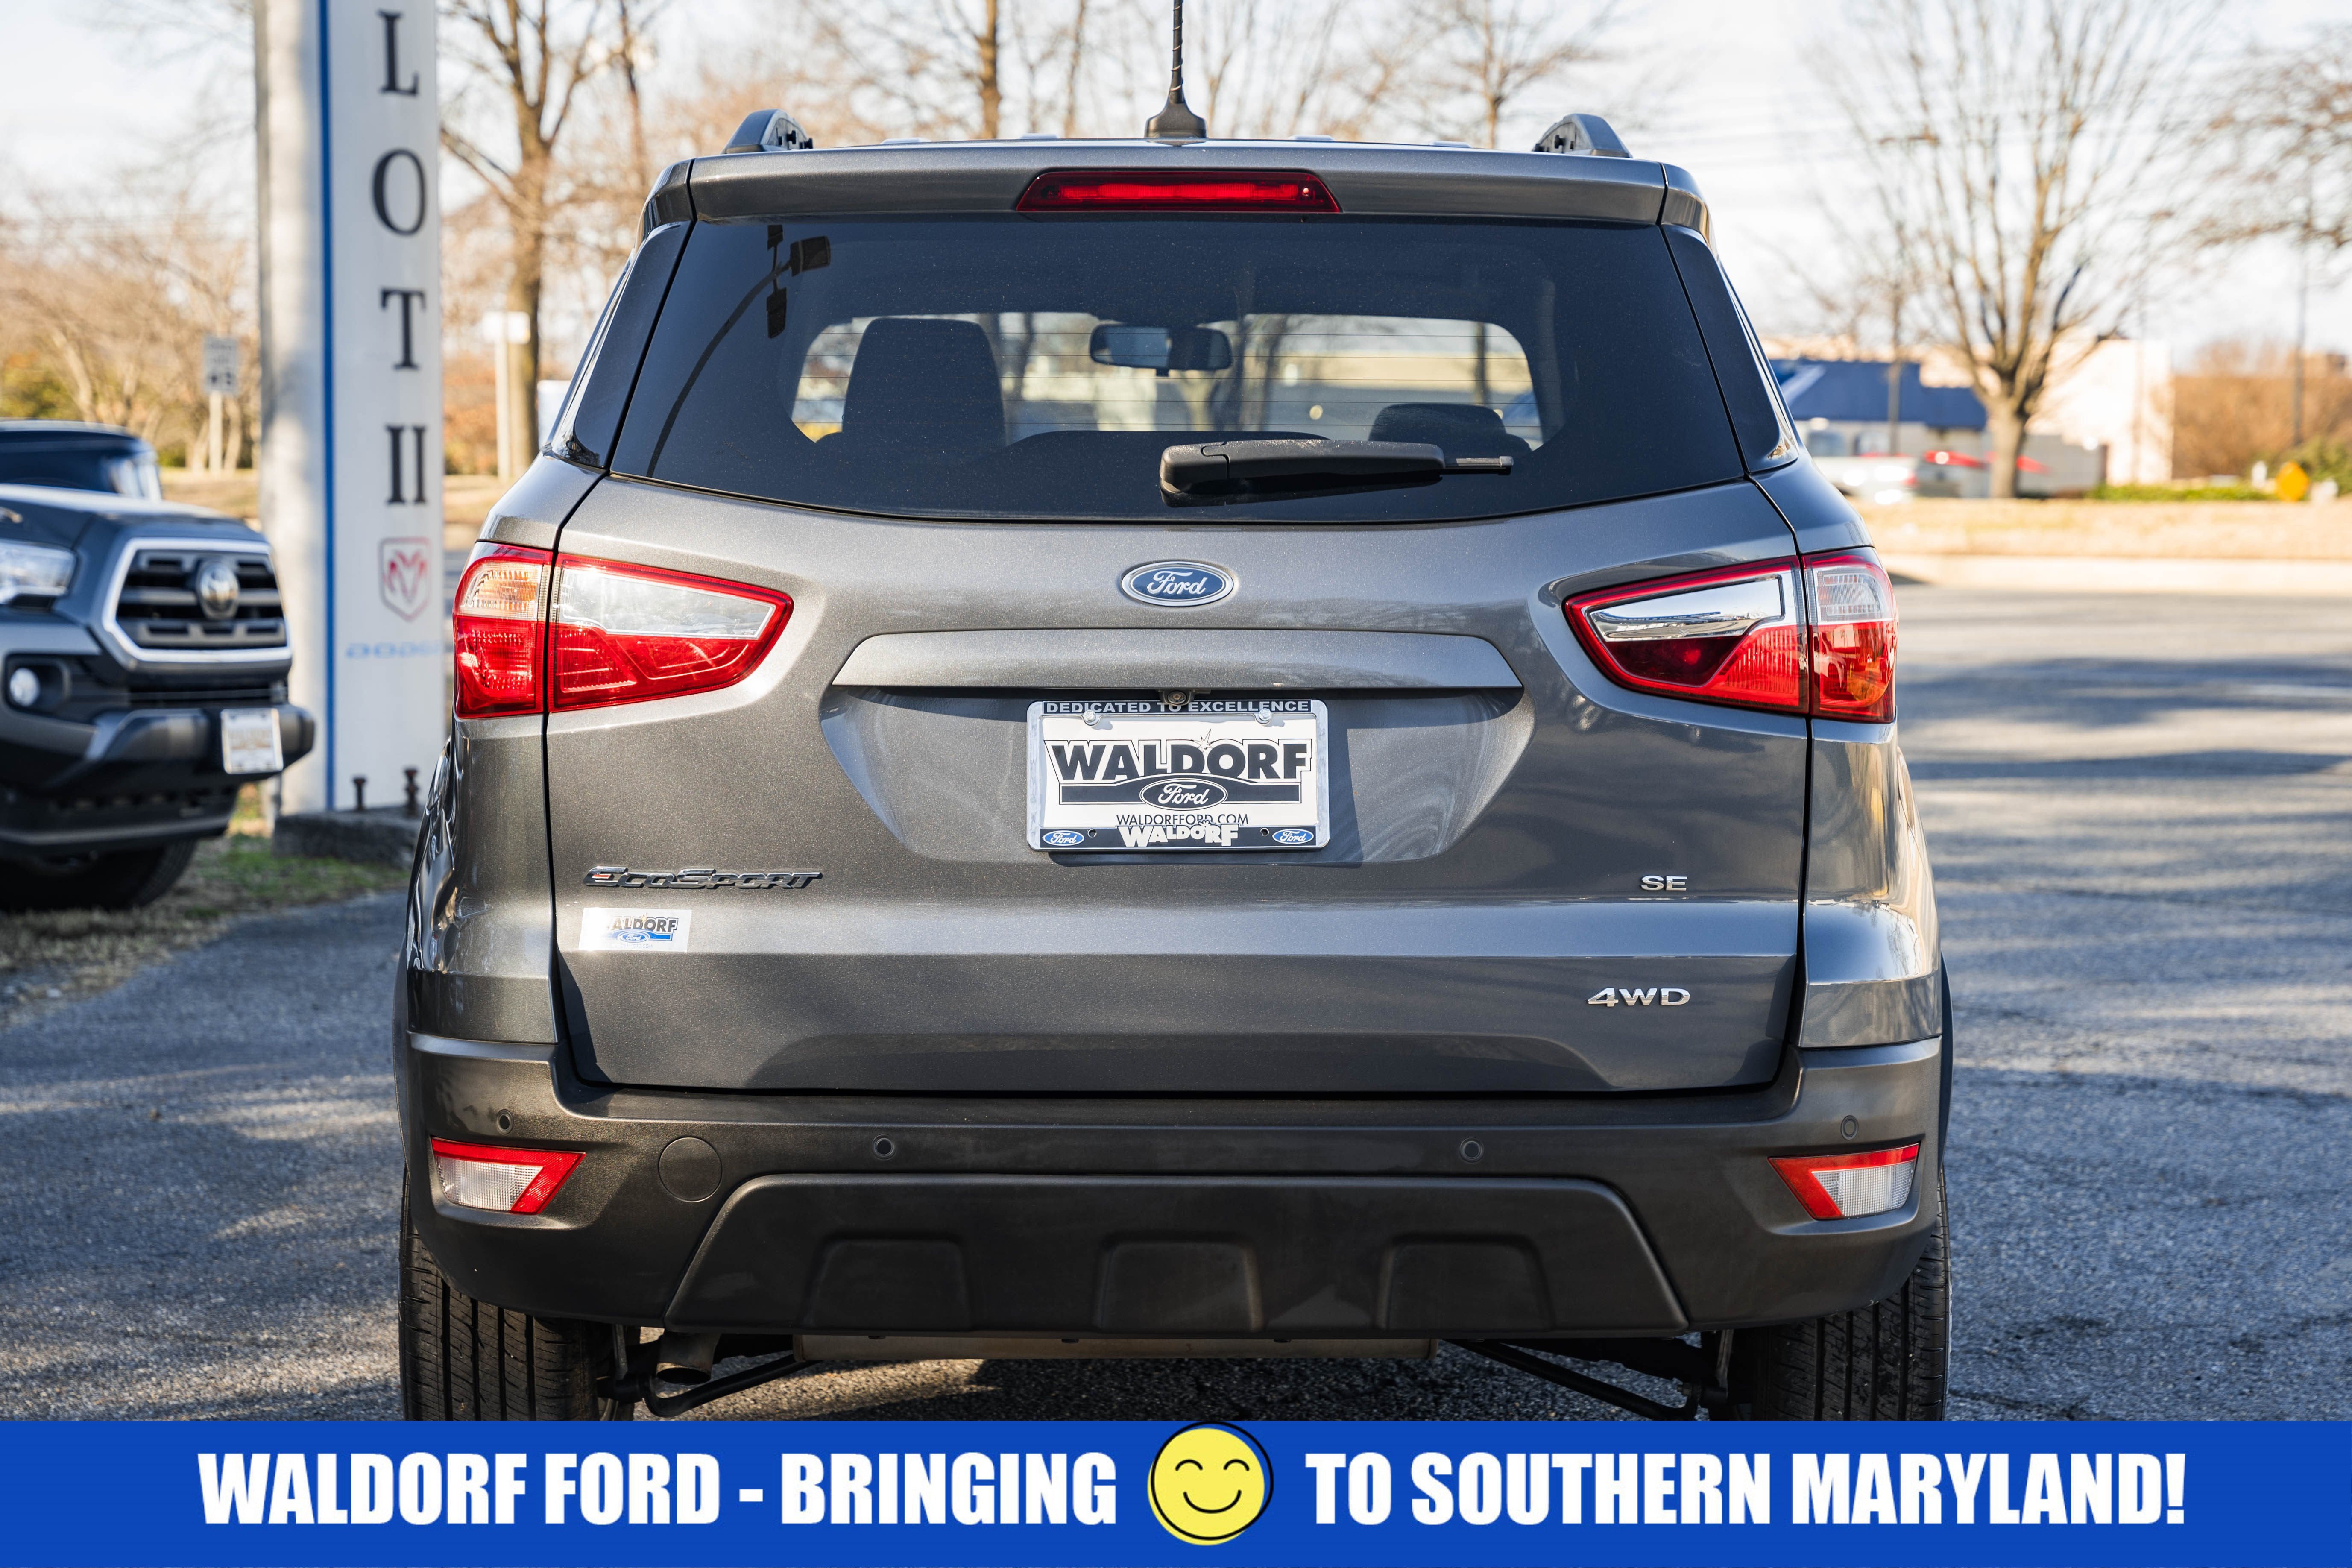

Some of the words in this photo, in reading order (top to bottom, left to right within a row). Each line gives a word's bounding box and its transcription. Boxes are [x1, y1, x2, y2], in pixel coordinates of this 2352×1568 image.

[371, 9, 427, 371] LOT
[1147, 570, 1208, 595] Ford
[1046, 702, 1151, 713] DEDICATED
[1157, 702, 1182, 712] TO
[1188, 701, 1309, 712] EXCELLENCE
[1051, 743, 1308, 780] WALDORF
[1158, 781, 1209, 806] Ford
[1048, 831, 1078, 844] Ford
[1117, 824, 1239, 847] WALDORF
[1278, 829, 1307, 843] Ford
[1640, 875, 1687, 891] SE
[606, 918, 677, 932] ALDORF
[1587, 987, 1690, 1007] 4WD
